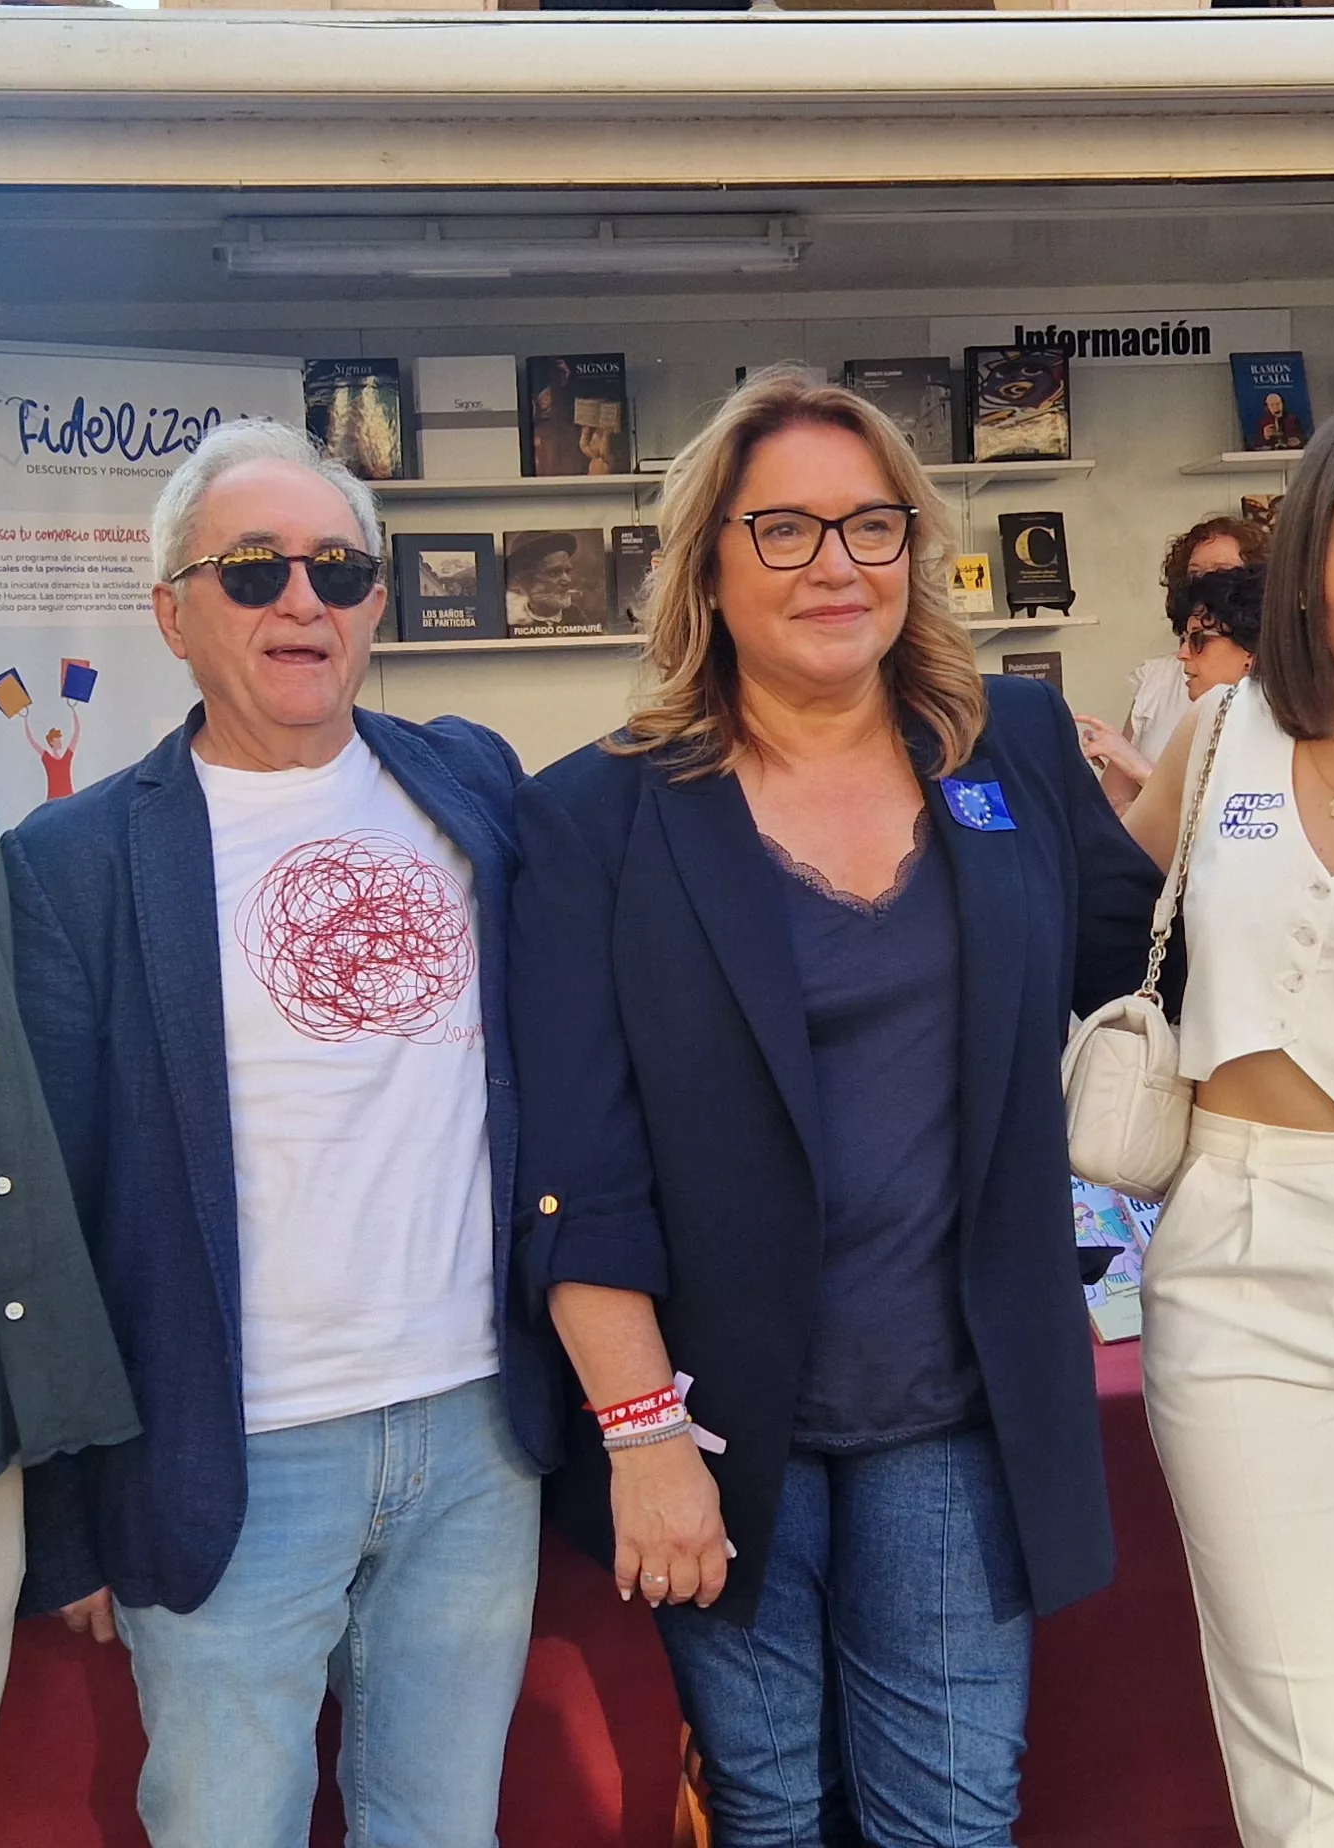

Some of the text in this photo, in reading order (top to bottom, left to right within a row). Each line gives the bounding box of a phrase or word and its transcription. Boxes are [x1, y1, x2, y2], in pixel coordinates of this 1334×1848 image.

[1014, 320, 1211, 358] Información
[576, 362, 620, 374] SIGNOS
[1250, 361, 1292, 374] RAMÓN
[1259, 373, 1294, 384] CAJAL
[26, 464, 176, 479] DESCUENTOS Y PROMOCION
[19, 526, 32, 542] tu
[1, 554, 13, 562] un
[15, 555, 59, 564] programa
[60, 554, 72, 562] de
[74, 554, 118, 562] incentivos
[121, 554, 128, 562] al
[21, 565, 34, 573] de
[35, 565, 44, 573] la
[45, 565, 85, 574] provincia
[87, 565, 99, 573] de
[101, 565, 135, 573] Huesca.
[10, 580, 49, 589] iniciativa
[51, 581, 91, 589] dinamiza
[92, 581, 100, 589] la
[102, 581, 141, 589] actividad
[39, 592, 54, 600] Las
[55, 593, 92, 602] compras
[107, 593, 120, 601] los
[16, 605, 37, 613] para
[38, 604, 64, 613] seguir
[66, 604, 117, 613] comprando
[422, 610, 437, 619] LOS
[439, 608, 465, 619] BAÑOS
[422, 618, 477, 628] DE PANTICOSA
[513, 623, 603, 636] RICARDO COMPAIRÉ
[1227, 794, 1284, 810] #USA
[1224, 809, 1254, 824] TU
[1220, 823, 1278, 840] VOTO
[628, 1397, 657, 1415] PSOE
[632, 1413, 663, 1428] PSOE
